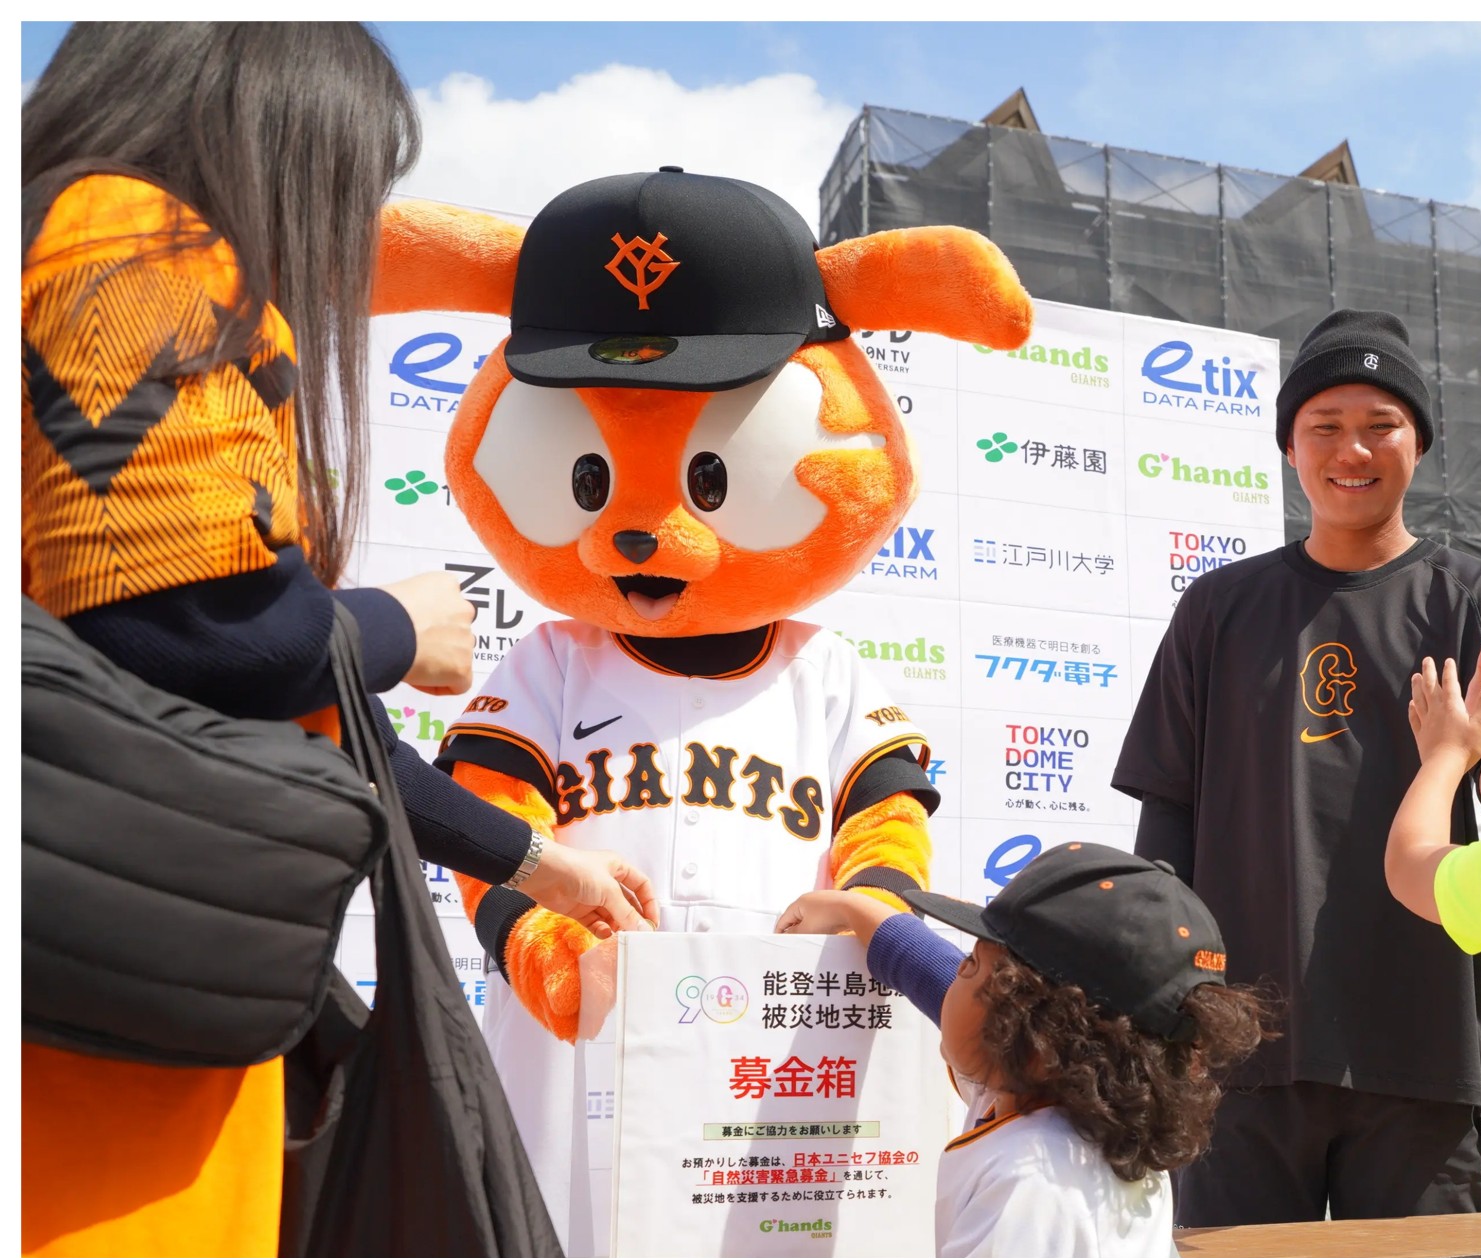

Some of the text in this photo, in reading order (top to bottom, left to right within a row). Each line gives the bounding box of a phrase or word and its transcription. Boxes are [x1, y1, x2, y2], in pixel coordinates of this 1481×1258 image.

[1070, 372, 1110, 389] GIANTS
[1141, 340, 1259, 400] etix
[1143, 391, 1261, 417] DATA FARM
[1020, 439, 1107, 475] 伊藤園
[1232, 491, 1271, 505] GIANTS
[1169, 531, 1247, 555] TOKYO
[871, 562, 938, 580] FARM
[1002, 543, 1114, 576] 江戸川大学
[991, 634, 1101, 656] 医療機器で明日を創る
[903, 665, 947, 681] GIANTS
[974, 653, 1118, 688] フクダ電子
[1005, 724, 1090, 749] TOKYO
[1005, 747, 1074, 771] DOME
[553, 742, 828, 841] GIANTS
[1005, 771, 1073, 793] CITY
[1005, 798, 1091, 813] 心が動く、心に残る。
[761, 1003, 893, 1030] 被災地支援
[728, 1055, 857, 1100] 募金箱
[721, 1124, 863, 1138] 募金にご協力をお願いします
[691, 1189, 893, 1204] 被災地を支援するために役立てられます。
